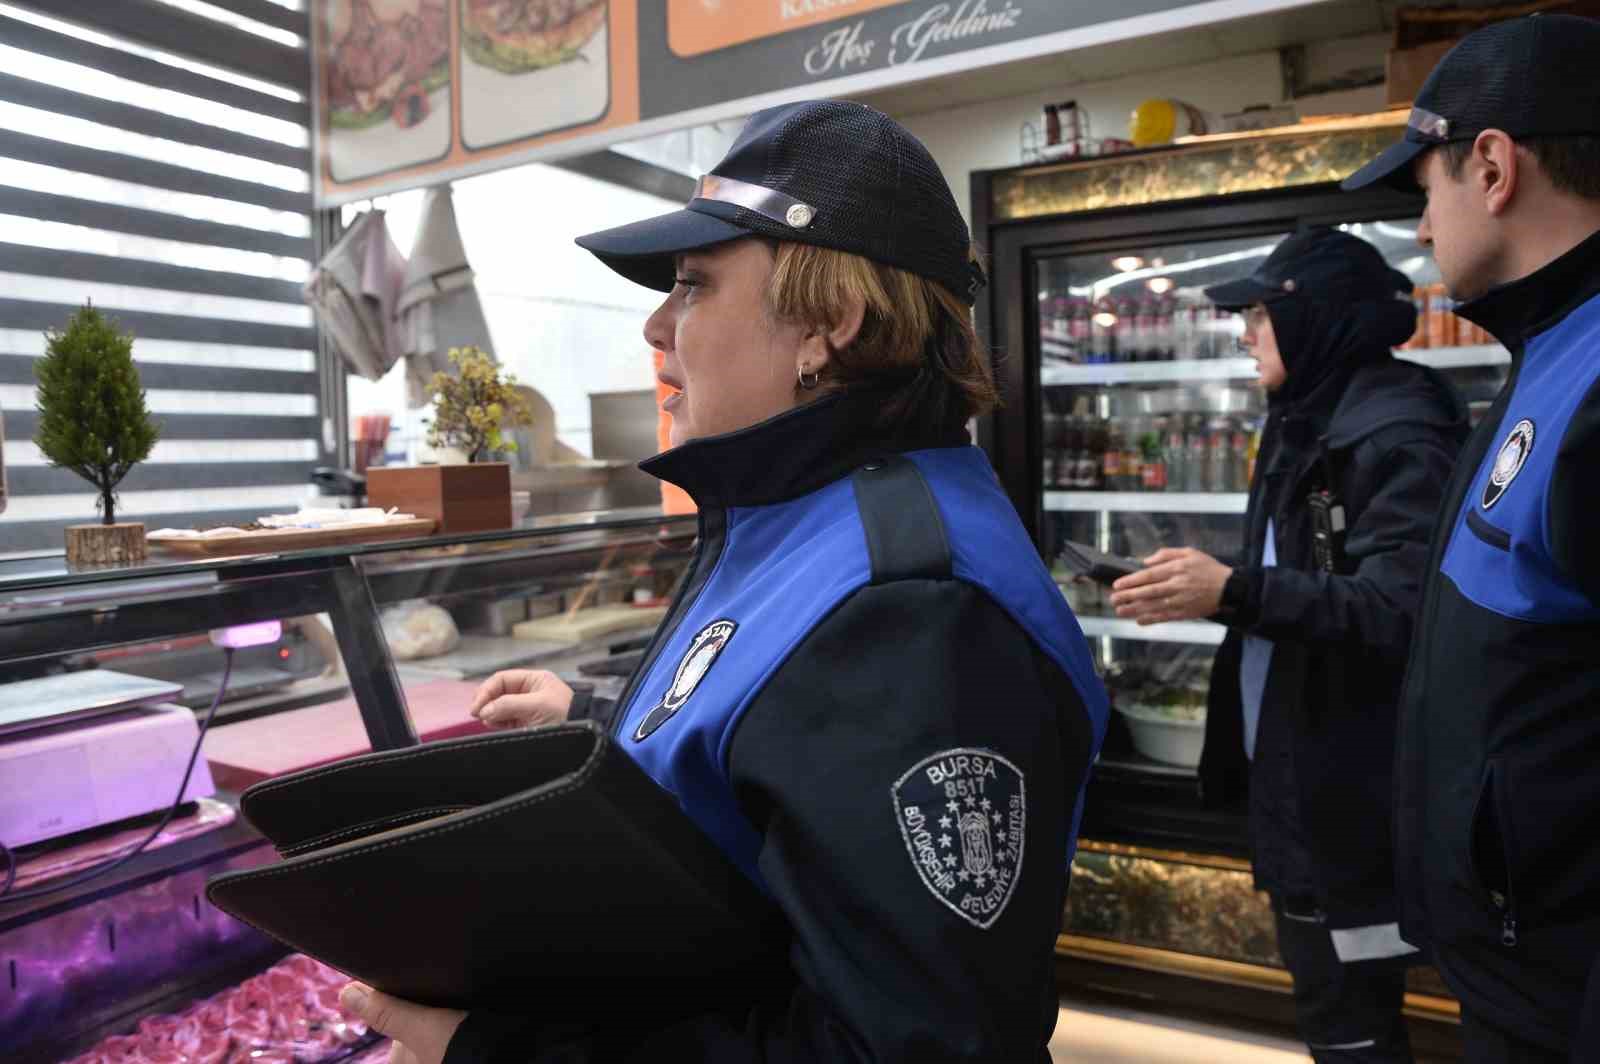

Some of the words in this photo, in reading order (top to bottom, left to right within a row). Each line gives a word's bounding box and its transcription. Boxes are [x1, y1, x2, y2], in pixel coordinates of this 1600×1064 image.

[804, 20, 874, 75] Hoş
[888, 0, 1022, 64] Geldiniz
[926, 756, 997, 784] BURSA
